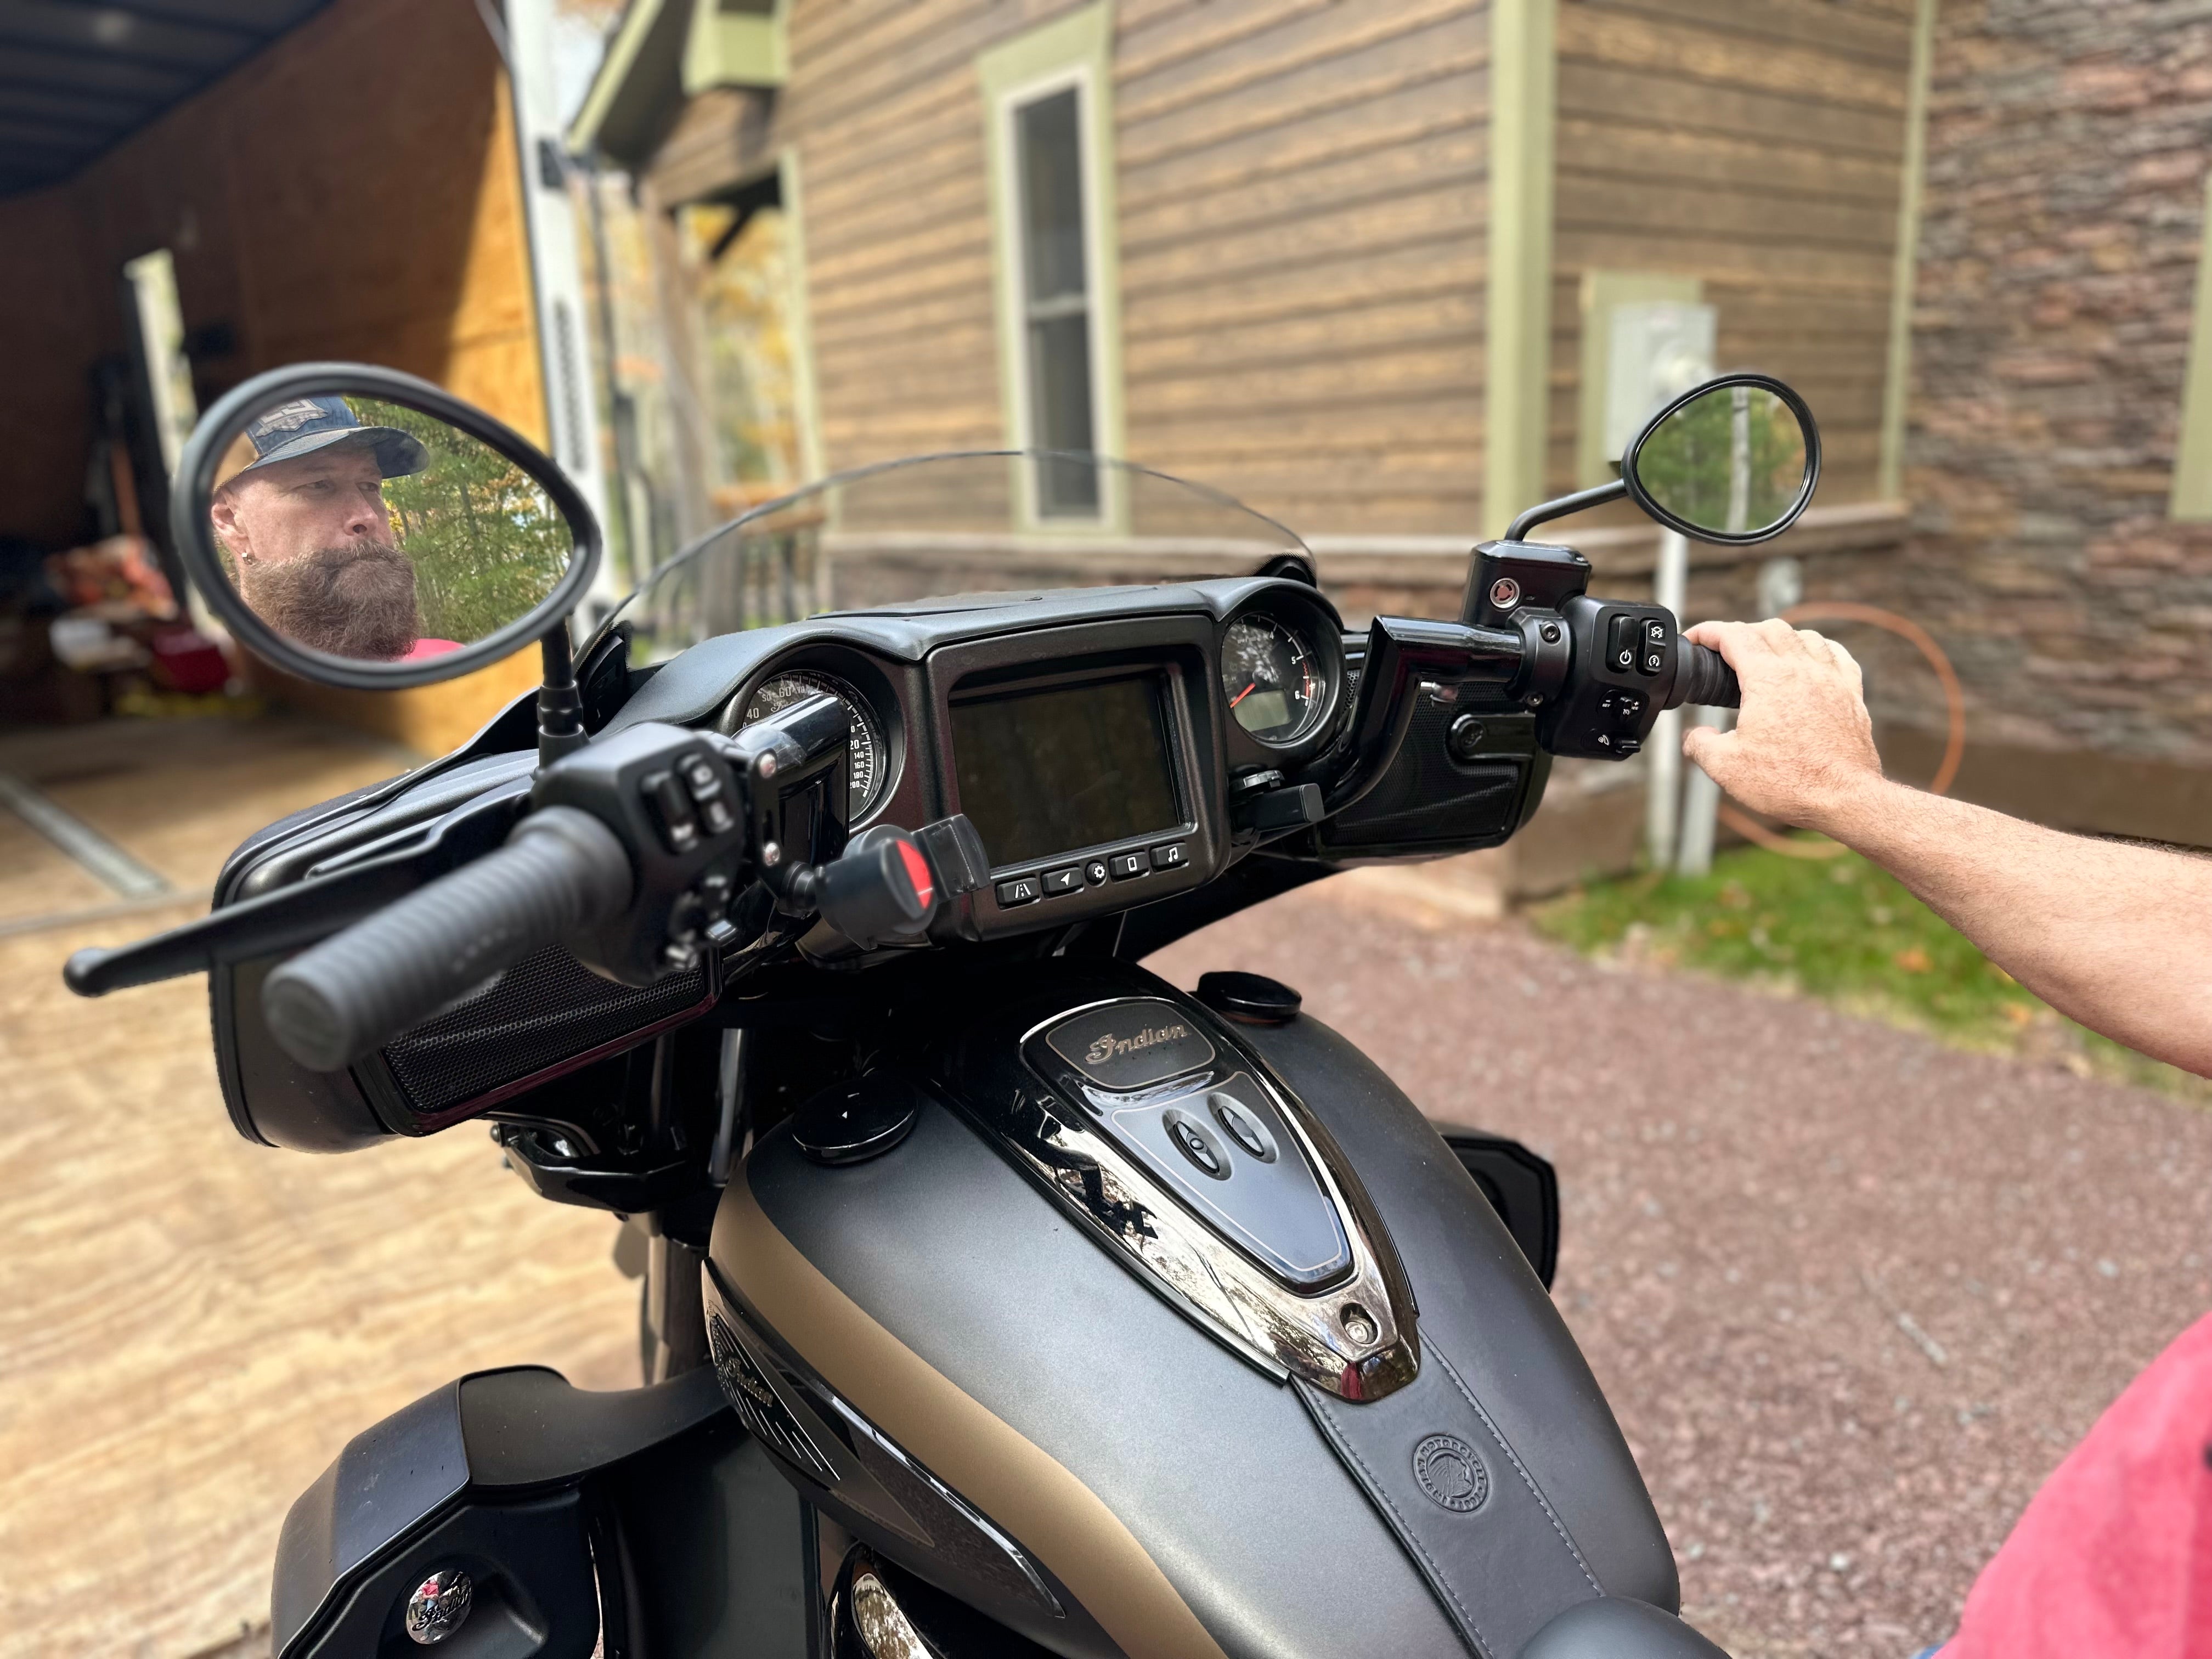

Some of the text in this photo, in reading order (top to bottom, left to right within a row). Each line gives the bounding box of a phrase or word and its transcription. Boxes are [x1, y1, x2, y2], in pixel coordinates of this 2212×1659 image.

[1291, 656, 1296, 664] 5
[779, 687, 791, 697] 60
[1295, 690, 1300, 699] 6
[761, 693, 771, 702] 50
[747, 708, 759, 719] 40
[850, 740, 860, 750] 20
[853, 771, 864, 779] 180
[1085, 1024, 1188, 1064] Indian
[1420, 1438, 1486, 1483] MOTORCYCLE
